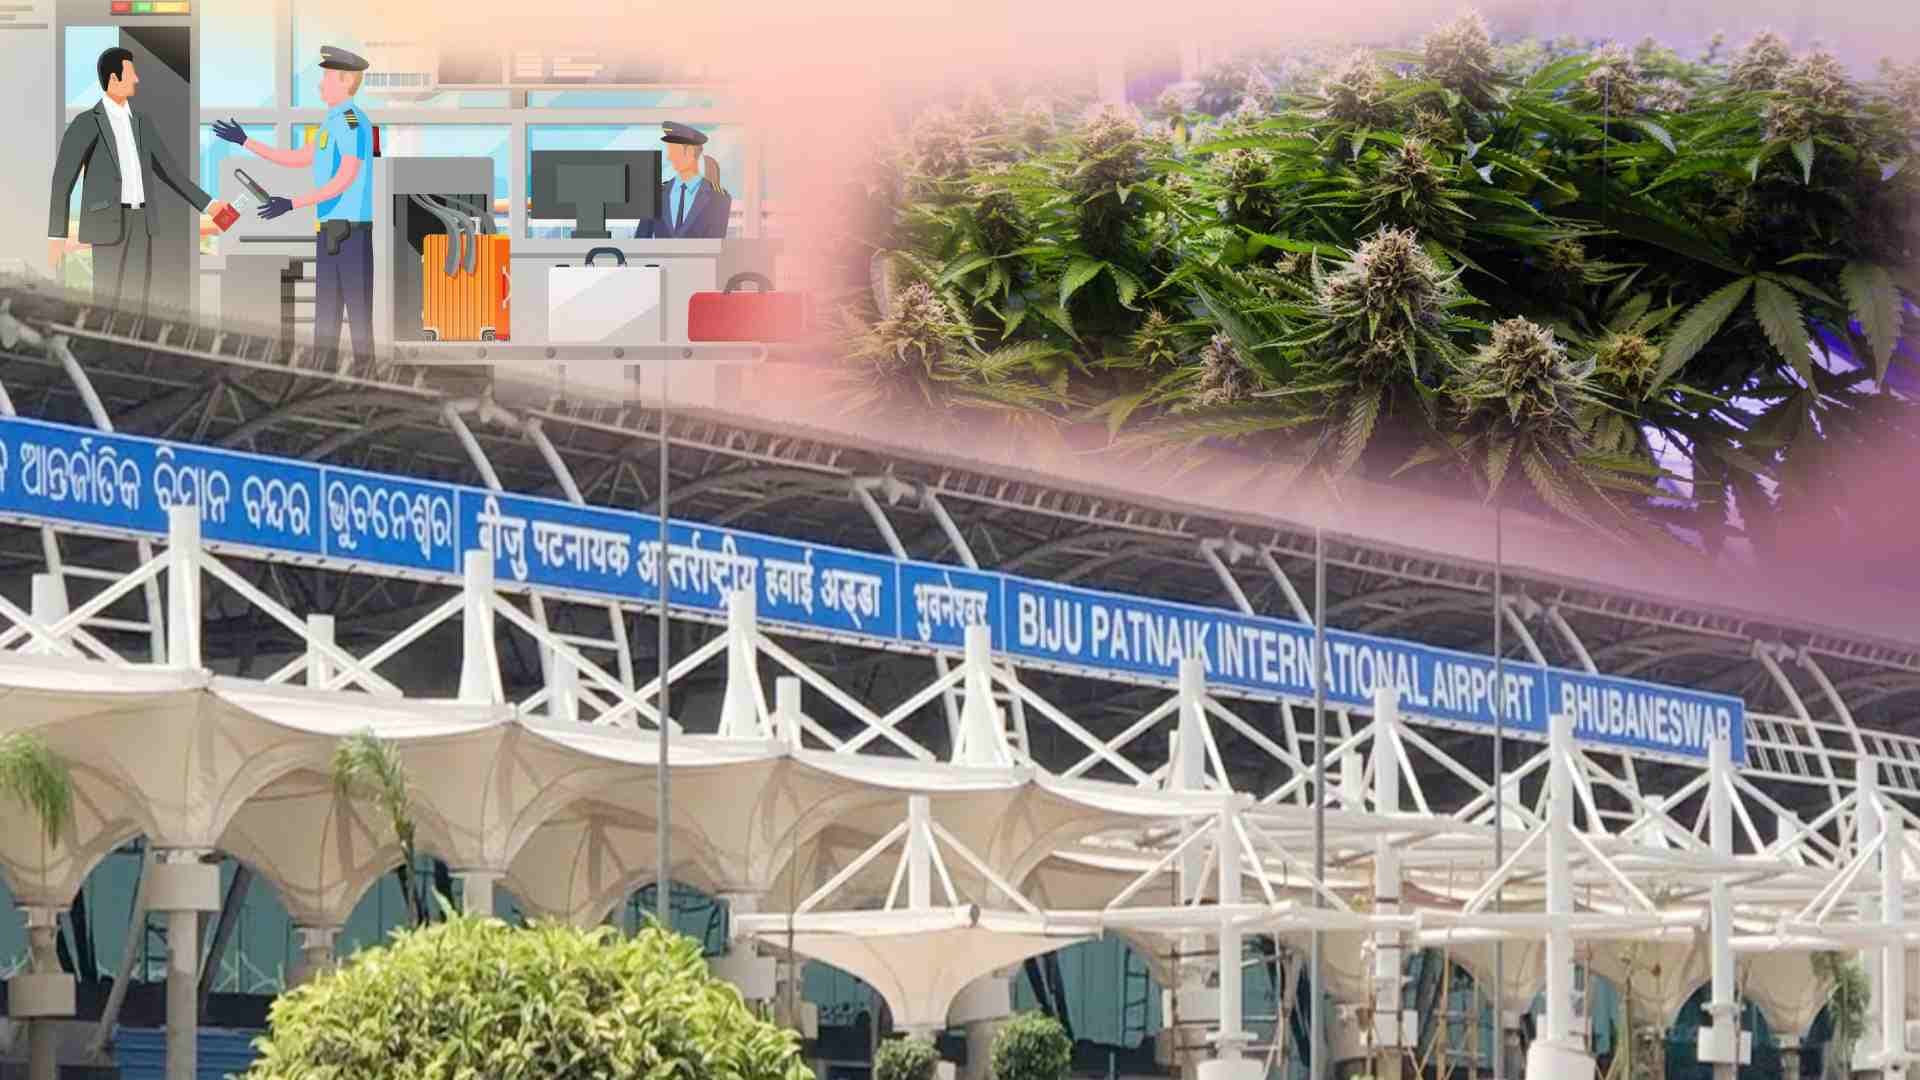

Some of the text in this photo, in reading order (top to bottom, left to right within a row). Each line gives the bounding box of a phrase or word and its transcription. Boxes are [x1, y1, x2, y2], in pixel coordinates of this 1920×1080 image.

[476, 495, 528, 581] बीजु
[531, 519, 631, 577] पटनायक
[763, 549, 814, 615] हवाई
[1018, 592, 1535, 723] BIJU PATNAIK INTERNATIONAL AIRPORT
[1561, 681, 1732, 749] BHUBANESWAR
